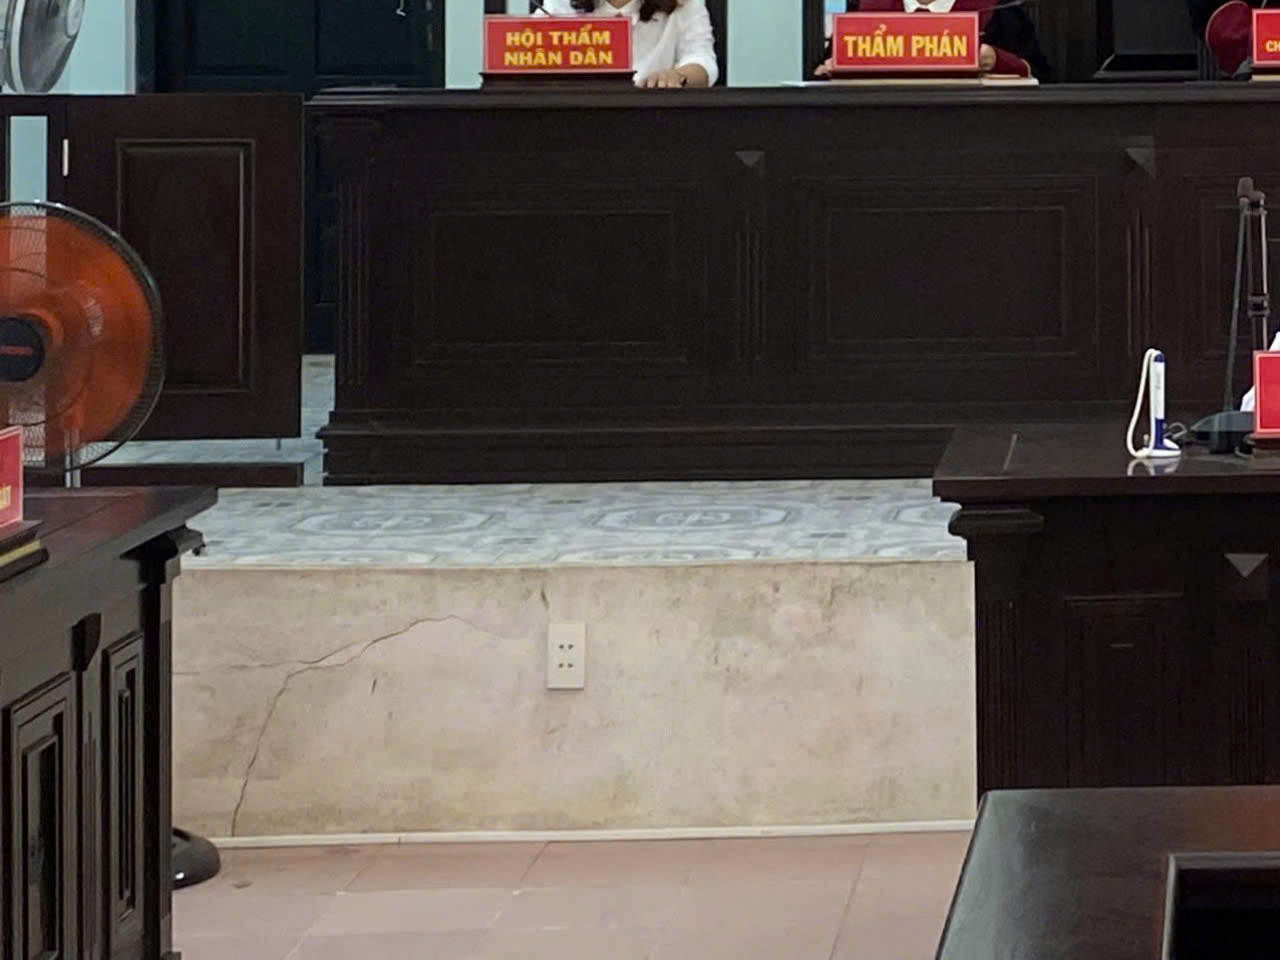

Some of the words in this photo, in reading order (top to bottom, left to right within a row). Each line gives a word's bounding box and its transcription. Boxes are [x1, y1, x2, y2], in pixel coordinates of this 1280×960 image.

[504, 27, 544, 48] HỘI
[843, 23, 905, 58] THẨM
[911, 29, 968, 58] PHÁN
[503, 47, 563, 66] NHÂN
[568, 46, 614, 66] DÂN
